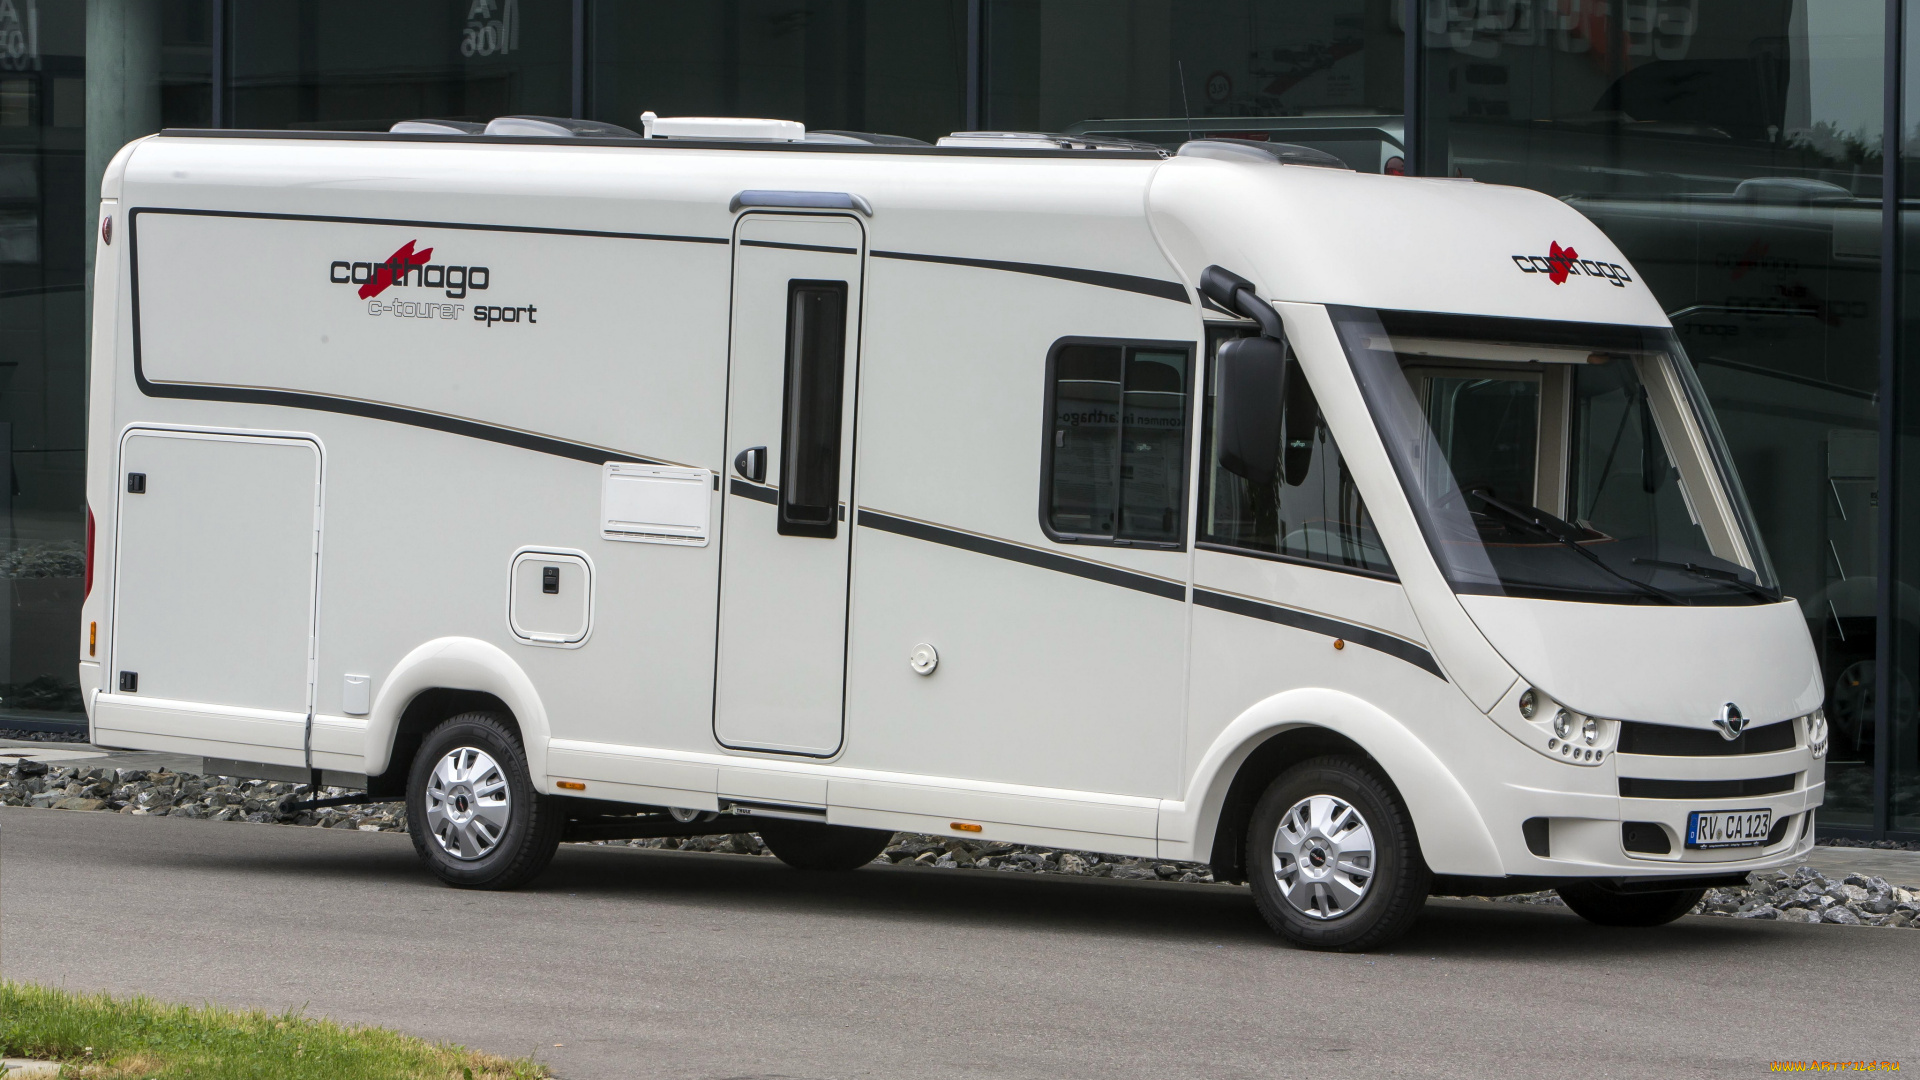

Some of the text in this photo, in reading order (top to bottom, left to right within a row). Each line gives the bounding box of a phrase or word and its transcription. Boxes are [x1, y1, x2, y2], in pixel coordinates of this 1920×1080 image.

[329, 257, 490, 299] carthago
[1511, 253, 1633, 288] carthago
[368, 297, 538, 328] c-tourer sport
[1698, 816, 1718, 840] RV
[1725, 815, 1742, 839] CA
[1745, 813, 1769, 838] 123
